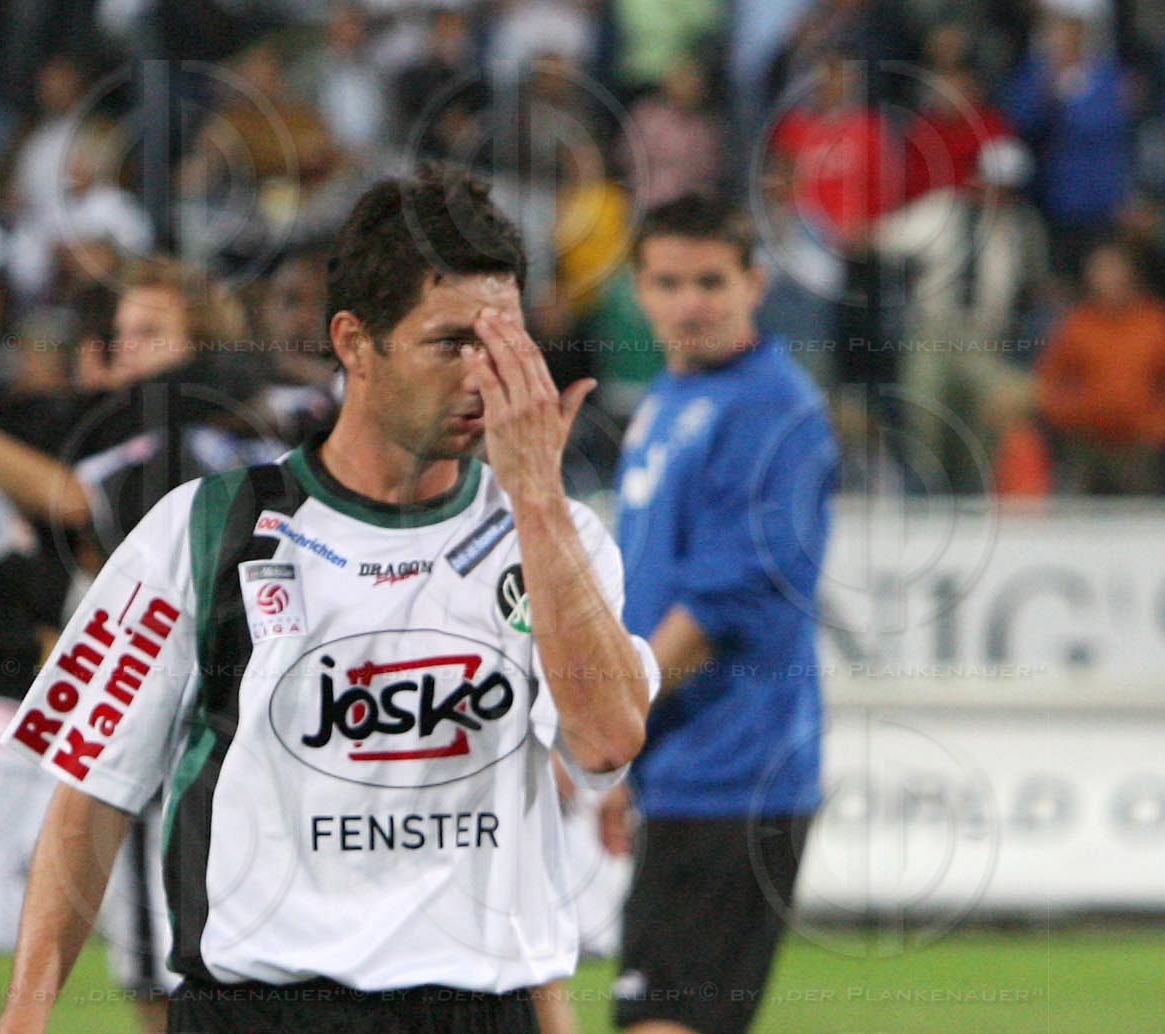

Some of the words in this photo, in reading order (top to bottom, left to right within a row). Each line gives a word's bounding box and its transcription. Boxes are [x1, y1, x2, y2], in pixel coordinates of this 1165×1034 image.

[52, 597, 180, 781] Kamin
[301, 655, 514, 748] josko
[311, 812, 500, 851] FENSTER
